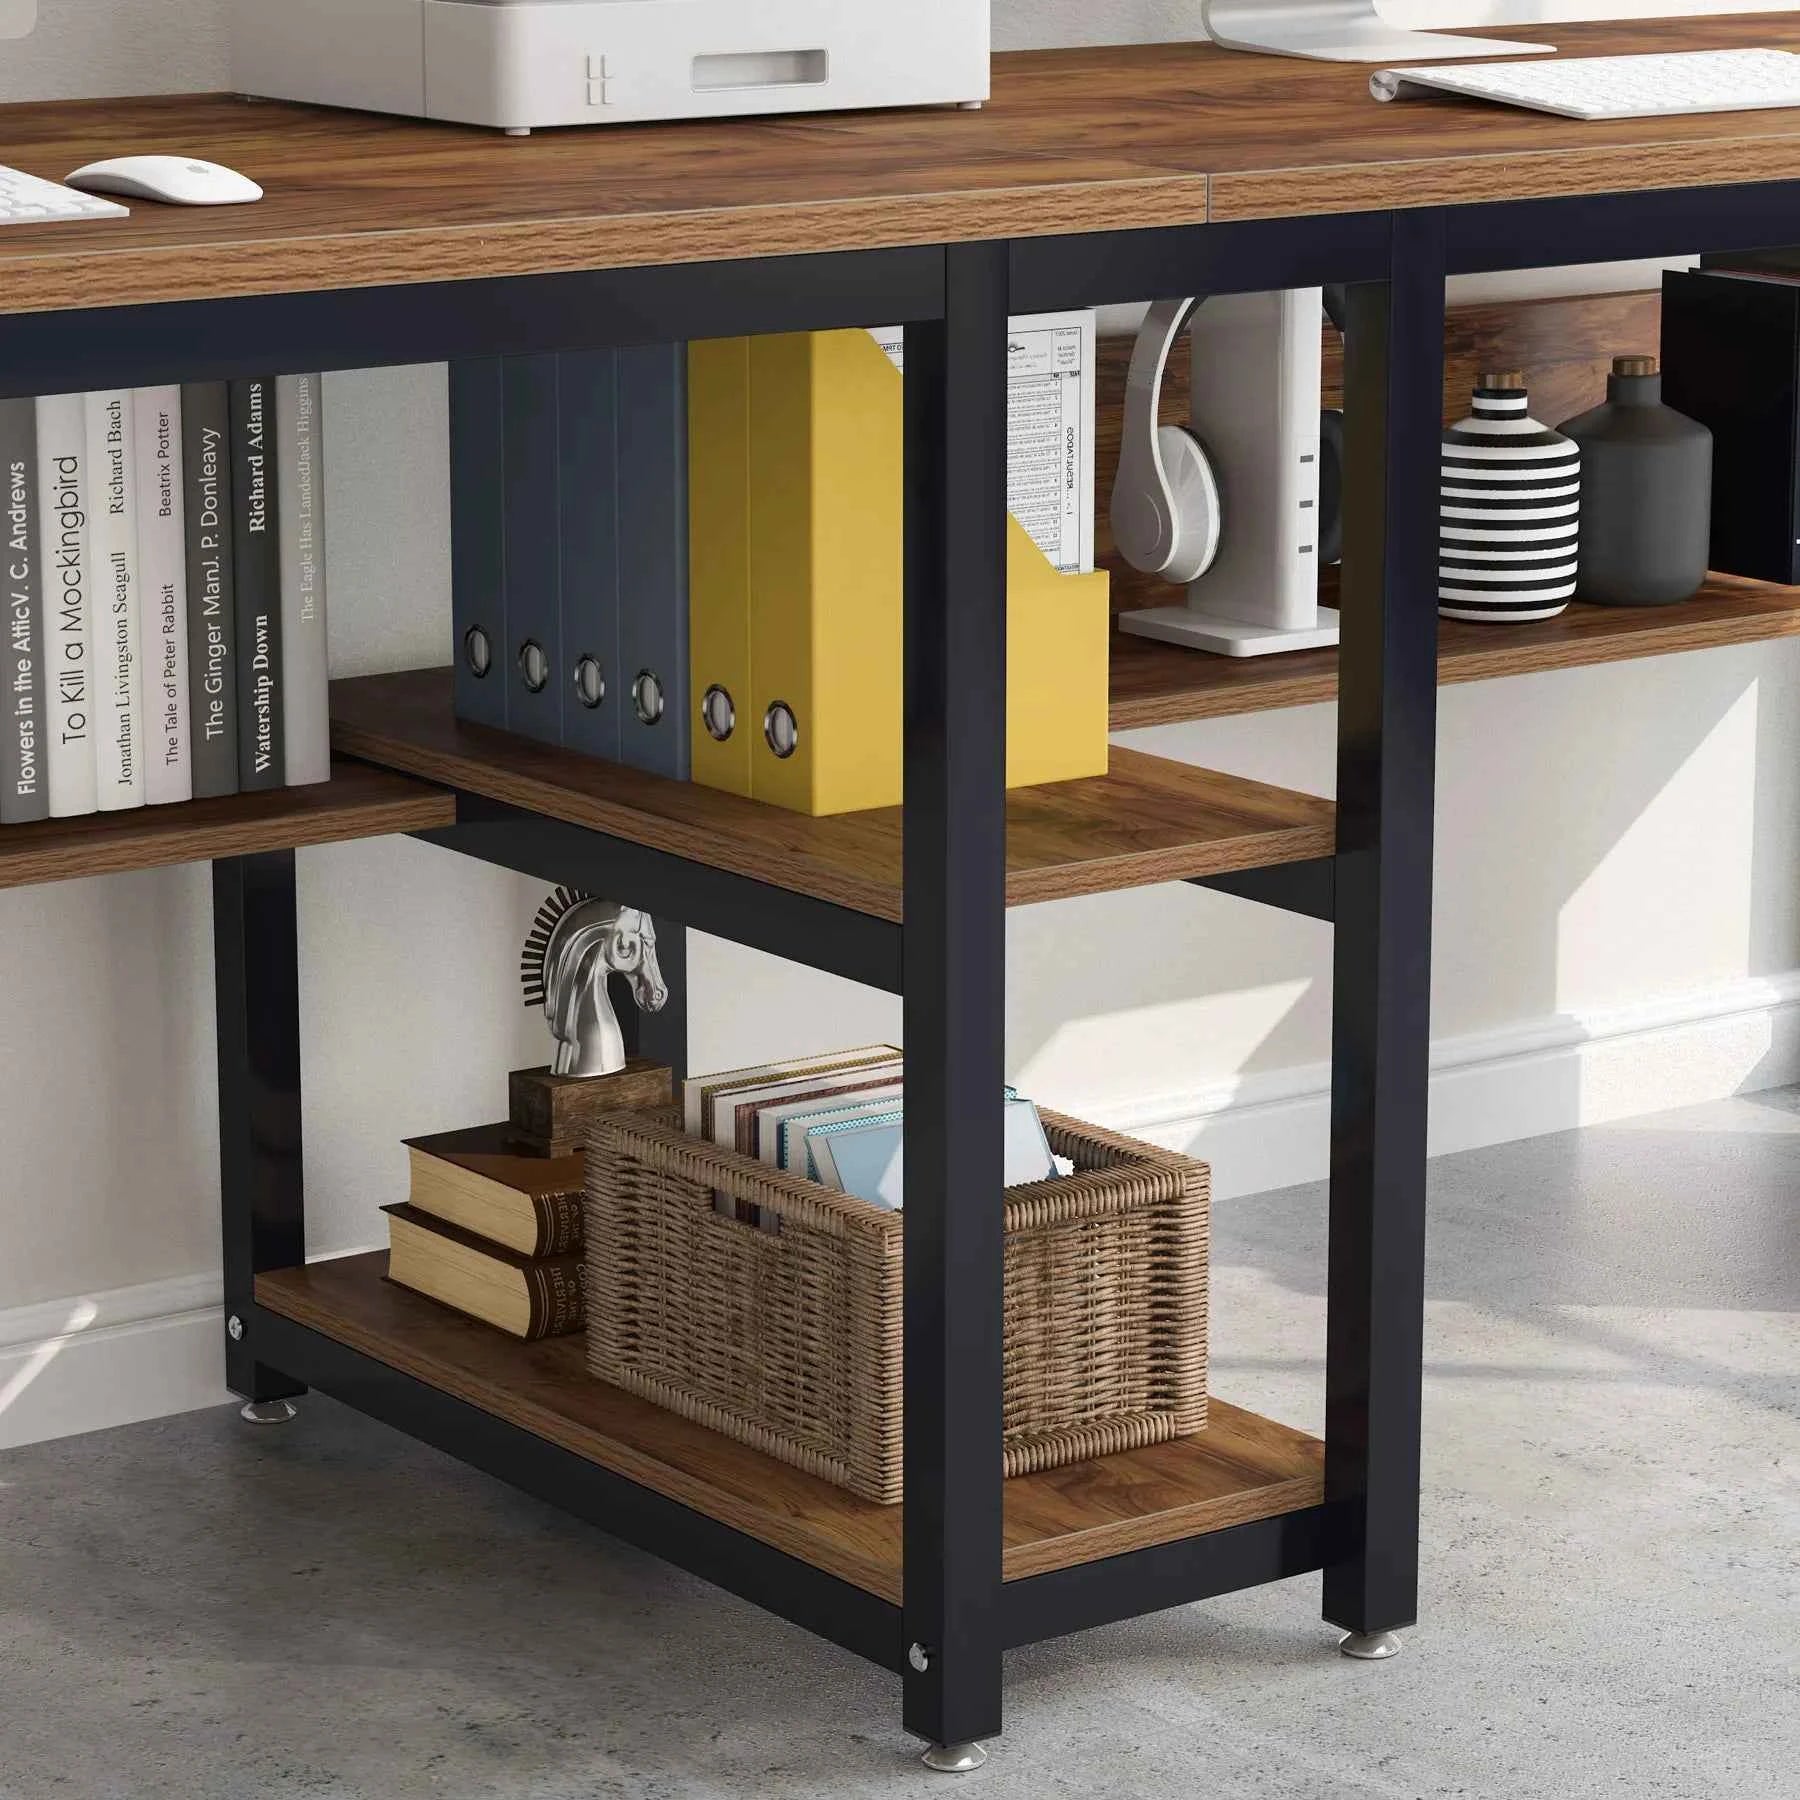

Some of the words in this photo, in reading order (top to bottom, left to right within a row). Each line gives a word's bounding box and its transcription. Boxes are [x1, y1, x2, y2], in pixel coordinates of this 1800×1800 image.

[106, 399, 123, 442] Bach
[247, 383, 264, 449] Adams
[296, 377, 313, 430] Higgins
[157, 411, 170, 459] Potter
[107, 448, 124, 514] Richard
[157, 463, 172, 517] Beatrix
[198, 427, 221, 527] Donleavy
[249, 455, 265, 533] Richard
[7, 461, 28, 550] Andrews
[52, 455, 85, 631] Mockingbird
[200, 534, 219, 549] P.
[299, 523, 313, 549] Has
[9, 557, 29, 580] C.
[110, 552, 130, 613] Seagull
[300, 553, 315, 592] Eagle
[161, 583, 175, 633] Rabbit
[302, 594, 314, 624] The
[65, 641, 84, 660] a
[114, 618, 133, 708] Livingston
[163, 638, 177, 678] Peter
[203, 622, 227, 694] Ginger
[252, 615, 269, 671] Down
[13, 658, 33, 692] the
[59, 669, 85, 703] Kill
[163, 682, 177, 698] of
[15, 696, 33, 715] in
[62, 712, 86, 744] To
[164, 703, 178, 733] Tale
[205, 699, 224, 740] The
[253, 674, 274, 773] Watership
[17, 719, 36, 795] Flowers
[116, 712, 133, 785] Jonathan
[166, 736, 179, 765] The
